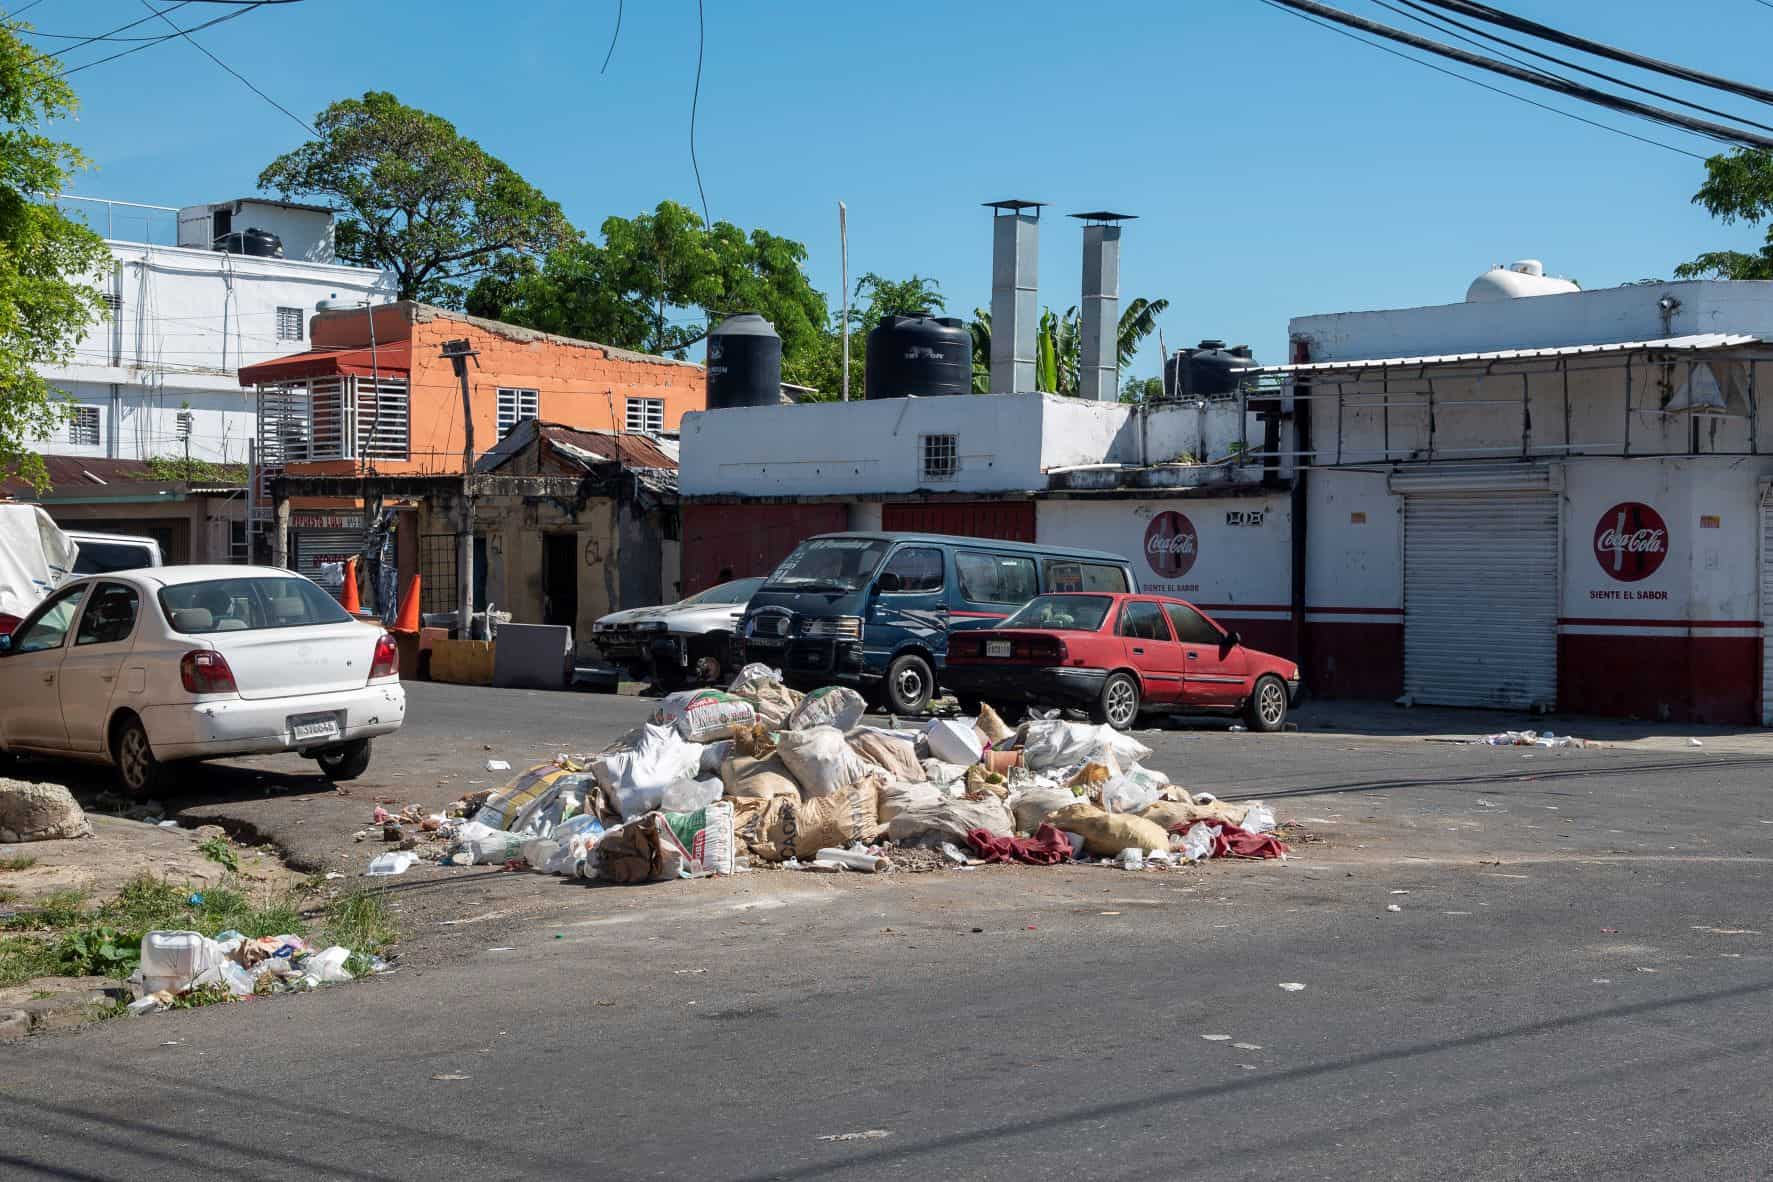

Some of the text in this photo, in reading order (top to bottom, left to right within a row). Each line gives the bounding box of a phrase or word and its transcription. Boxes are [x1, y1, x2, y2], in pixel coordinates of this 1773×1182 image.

[1590, 590, 1668, 600] SIENTE EL SABOR
